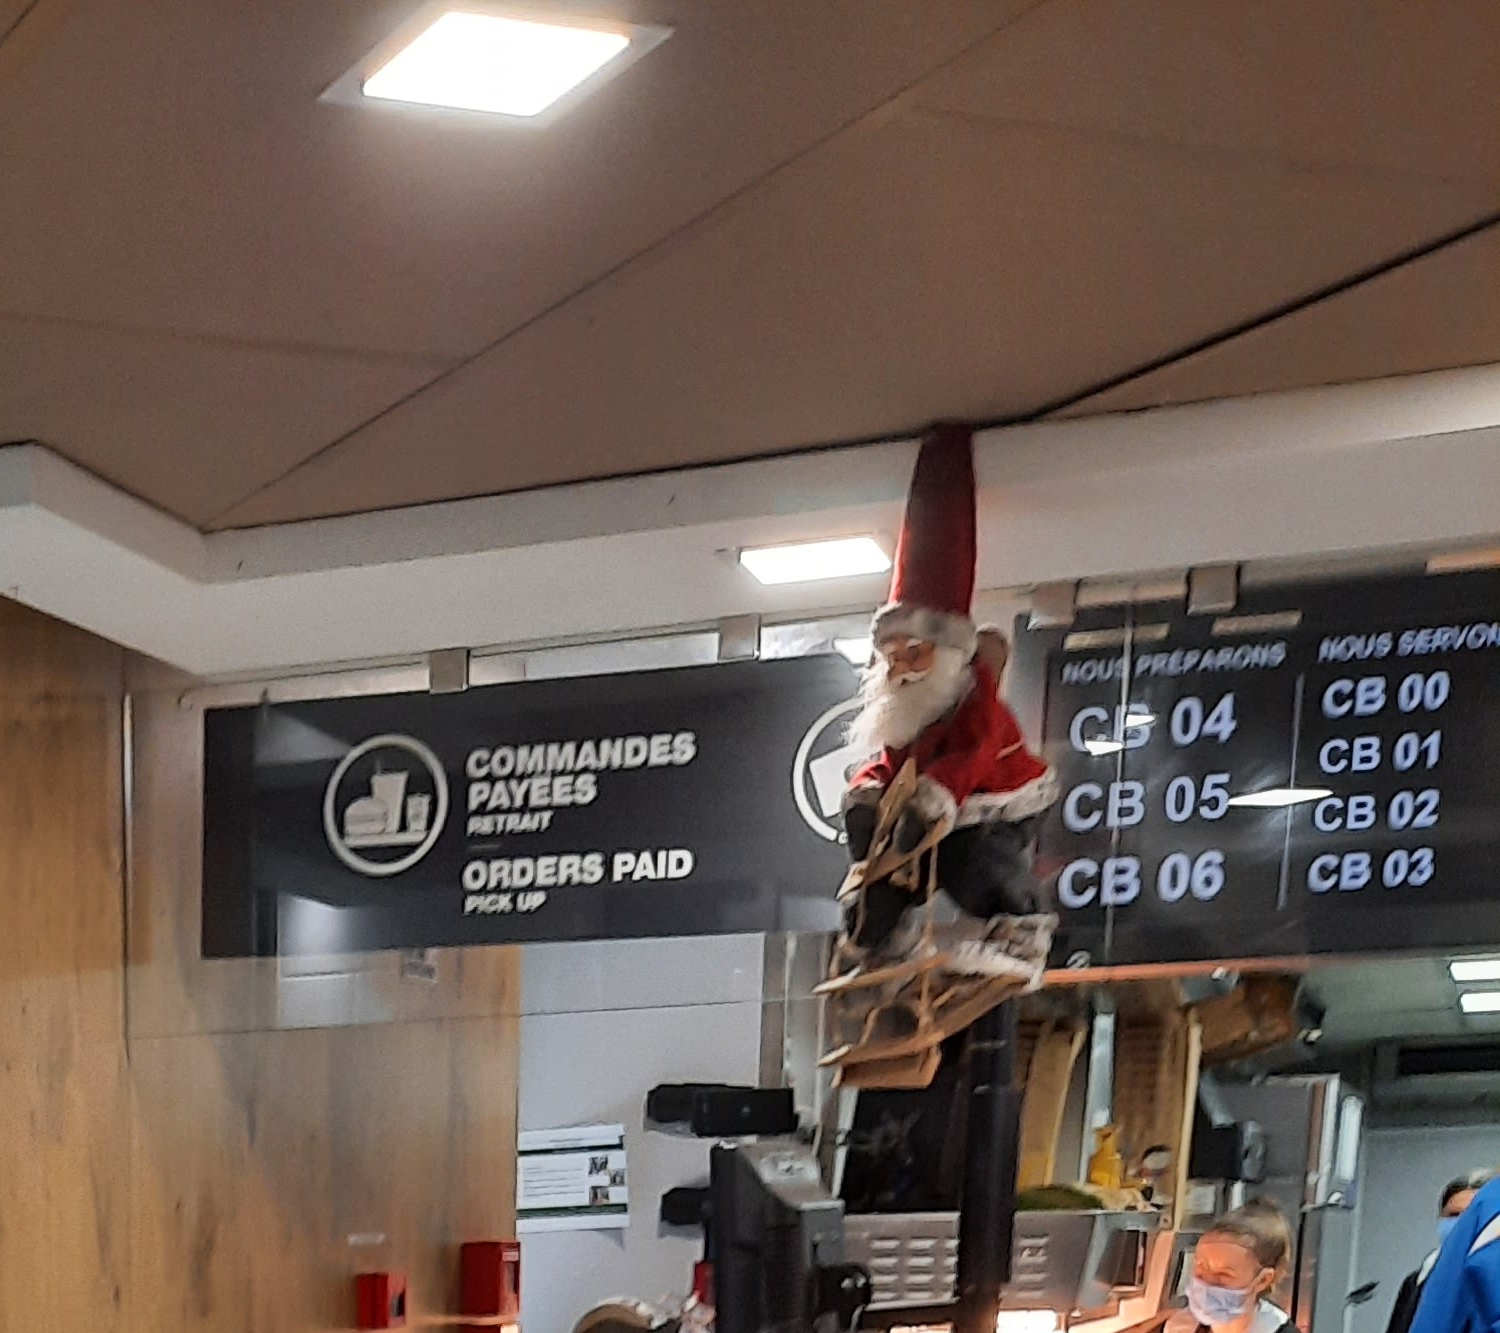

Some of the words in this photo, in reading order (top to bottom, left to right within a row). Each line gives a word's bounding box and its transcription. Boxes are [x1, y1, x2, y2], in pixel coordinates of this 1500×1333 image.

[1317, 631, 1393, 663] NOUS
[1322, 676, 1388, 719] CB
[1397, 670, 1451, 713] 00
[1069, 703, 1152, 753] CB
[1170, 692, 1237, 746] 04
[465, 731, 697, 780] COMMANDES
[1318, 735, 1382, 774] CB
[1392, 729, 1442, 772] 01
[467, 773, 599, 813] PAYEES
[1063, 780, 1146, 833] CB
[1164, 771, 1231, 823] 05
[1313, 795, 1377, 833] CB
[1387, 788, 1441, 831] 02
[466, 810, 555, 838] RETRAIT
[462, 852, 605, 892] ORDERS
[612, 849, 694, 882] PAID
[1057, 856, 1143, 910] CB
[1156, 849, 1227, 903] 06
[1306, 852, 1373, 893] CB
[1381, 847, 1437, 888] 03
[463, 893, 514, 917] PICK
[516, 891, 548, 914] UP
